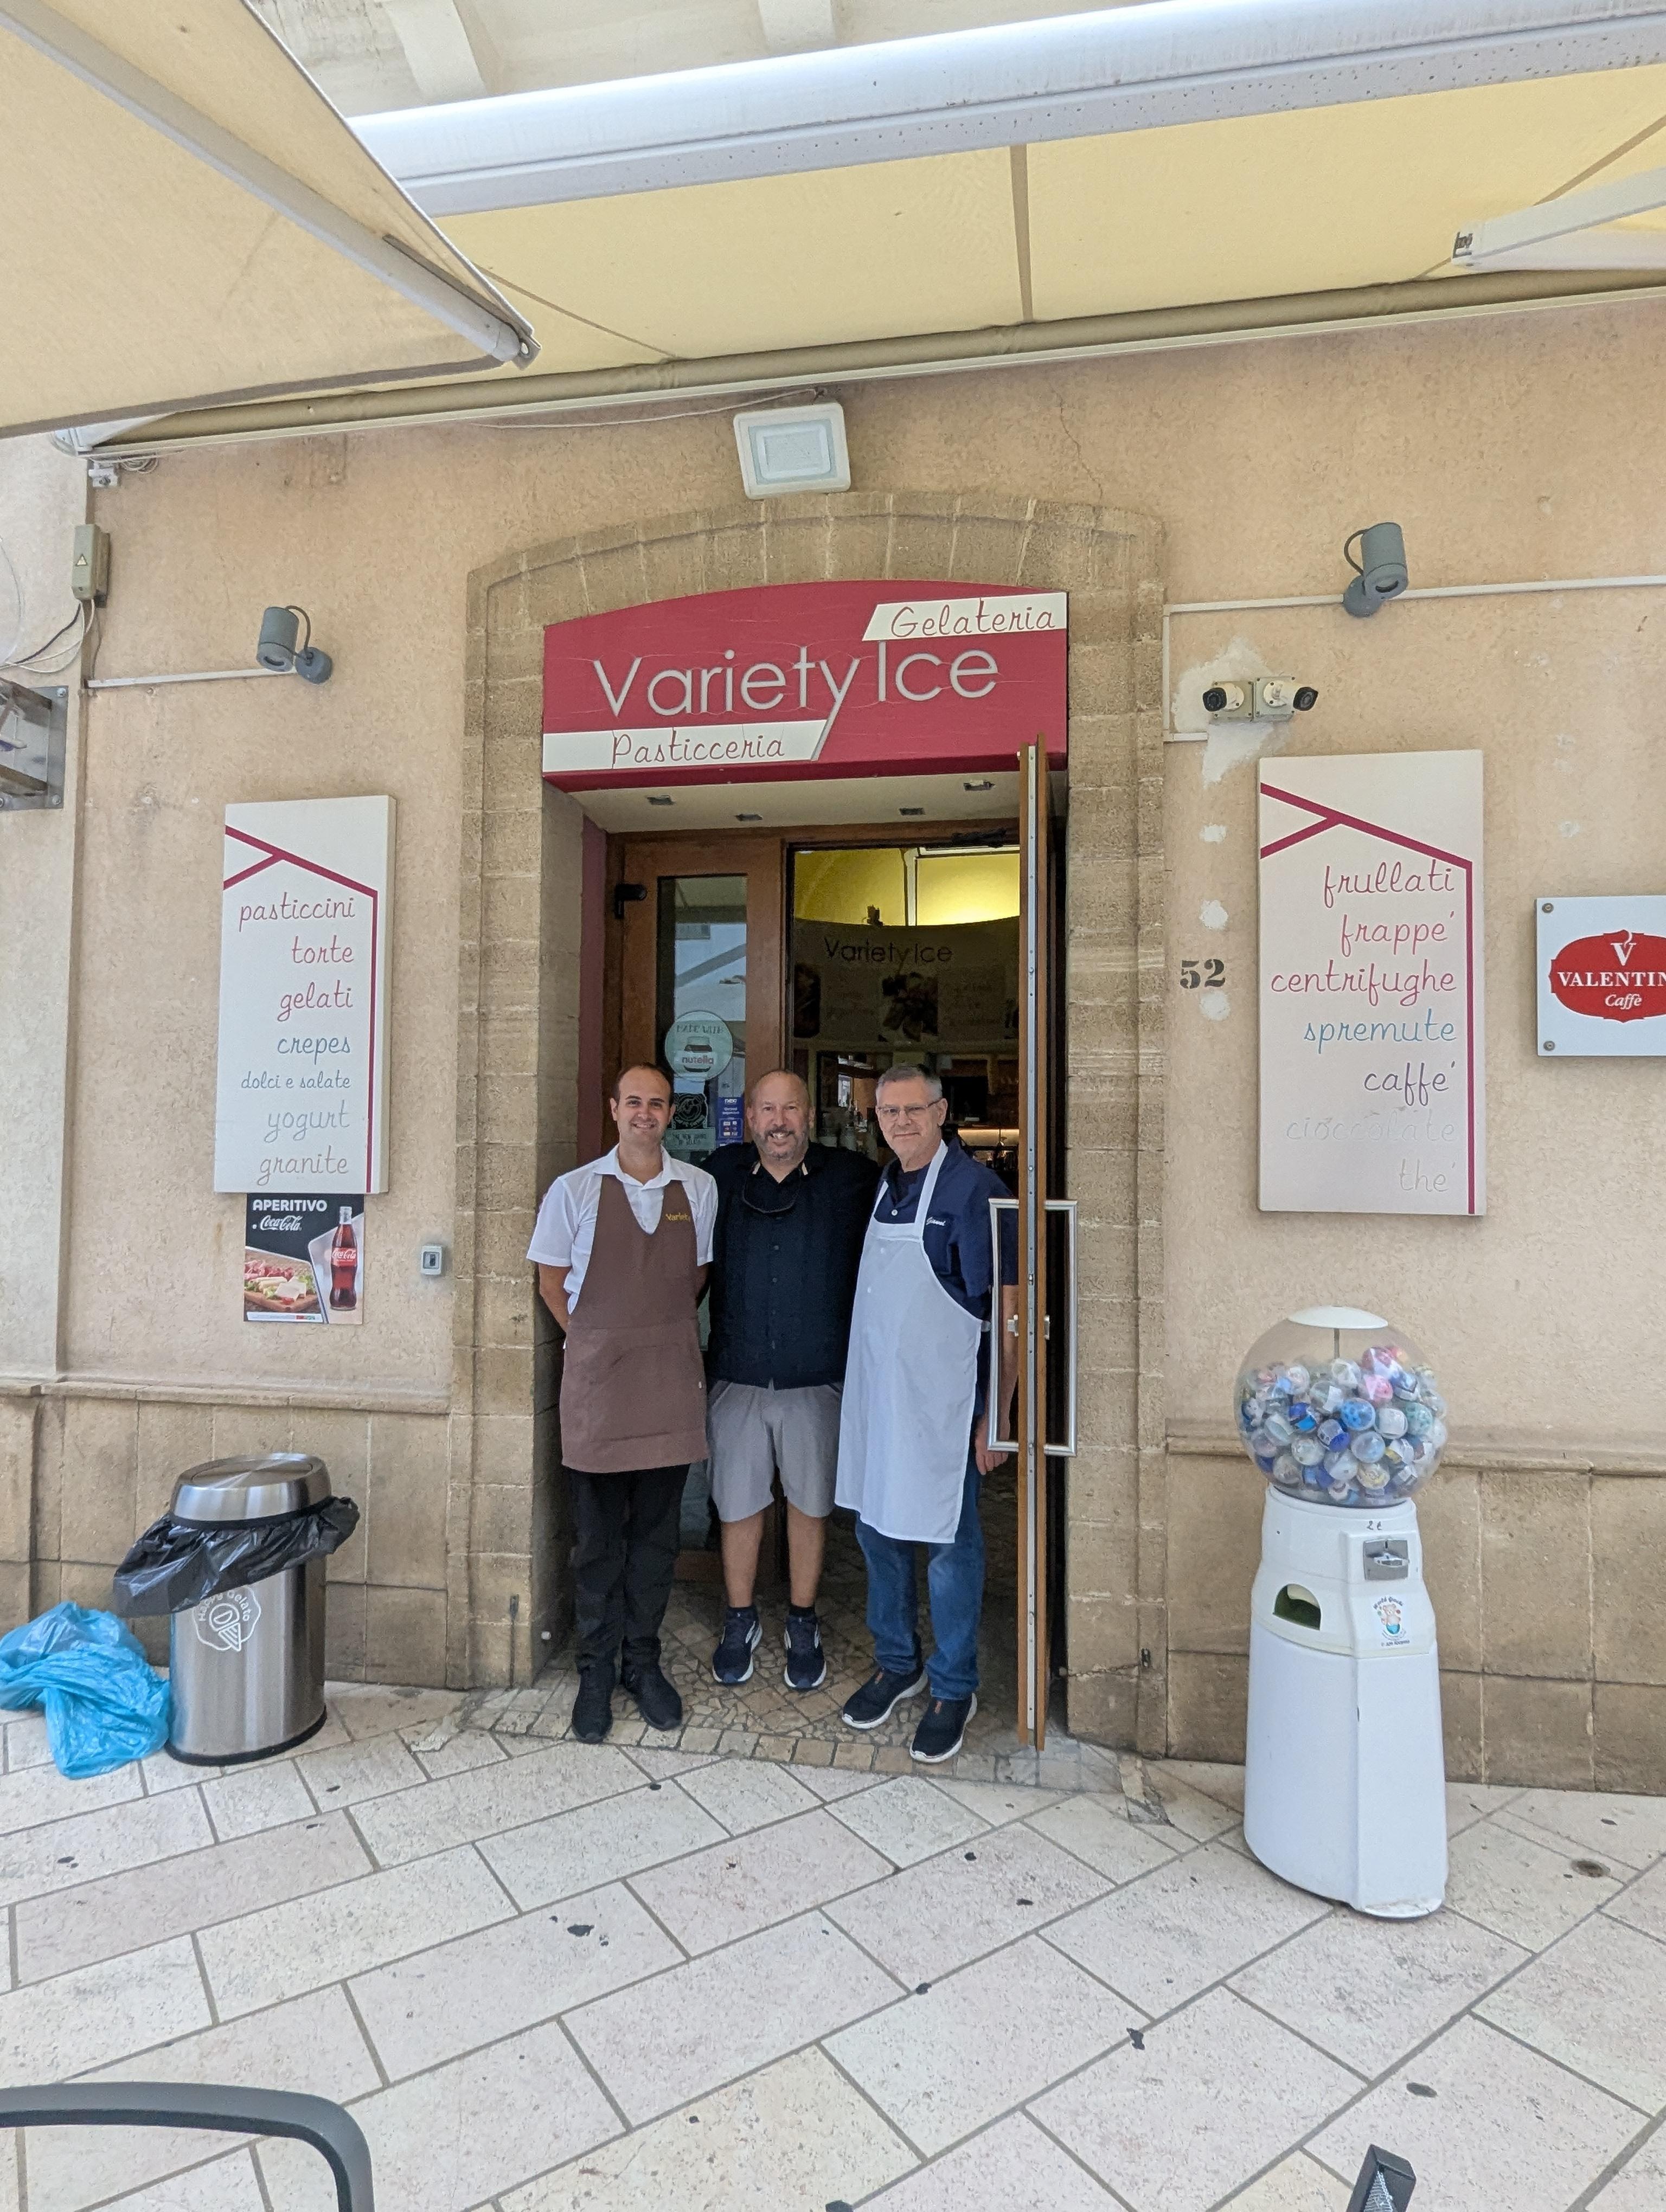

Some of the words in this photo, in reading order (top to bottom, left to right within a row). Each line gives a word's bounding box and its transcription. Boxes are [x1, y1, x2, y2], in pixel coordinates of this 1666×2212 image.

[891, 599, 1055, 637] Gelateria
[593, 646, 859, 761] Variety
[878, 641, 999, 702] Ice
[612, 729, 785, 767] Pasticceria
[1324, 859, 1455, 909] frullati
[239, 892, 356, 932] pasticcini
[291, 935, 355, 964] torte
[1180, 959, 1226, 989] 52
[1271, 959, 1457, 1007] centrifughe
[277, 980, 354, 1022] gelati
[1303, 1007, 1457, 1054] spremute
[277, 1037, 351, 1065] crepes
[682, 1054, 714, 1064] nutella
[241, 1071, 281, 1089] dolci
[286, 1078, 294, 1089] e
[299, 1069, 351, 1089] salate
[264, 1099, 350, 1142] yogurt
[256, 1145, 349, 1186] granite
[252, 1199, 328, 1212] APERITIVO
